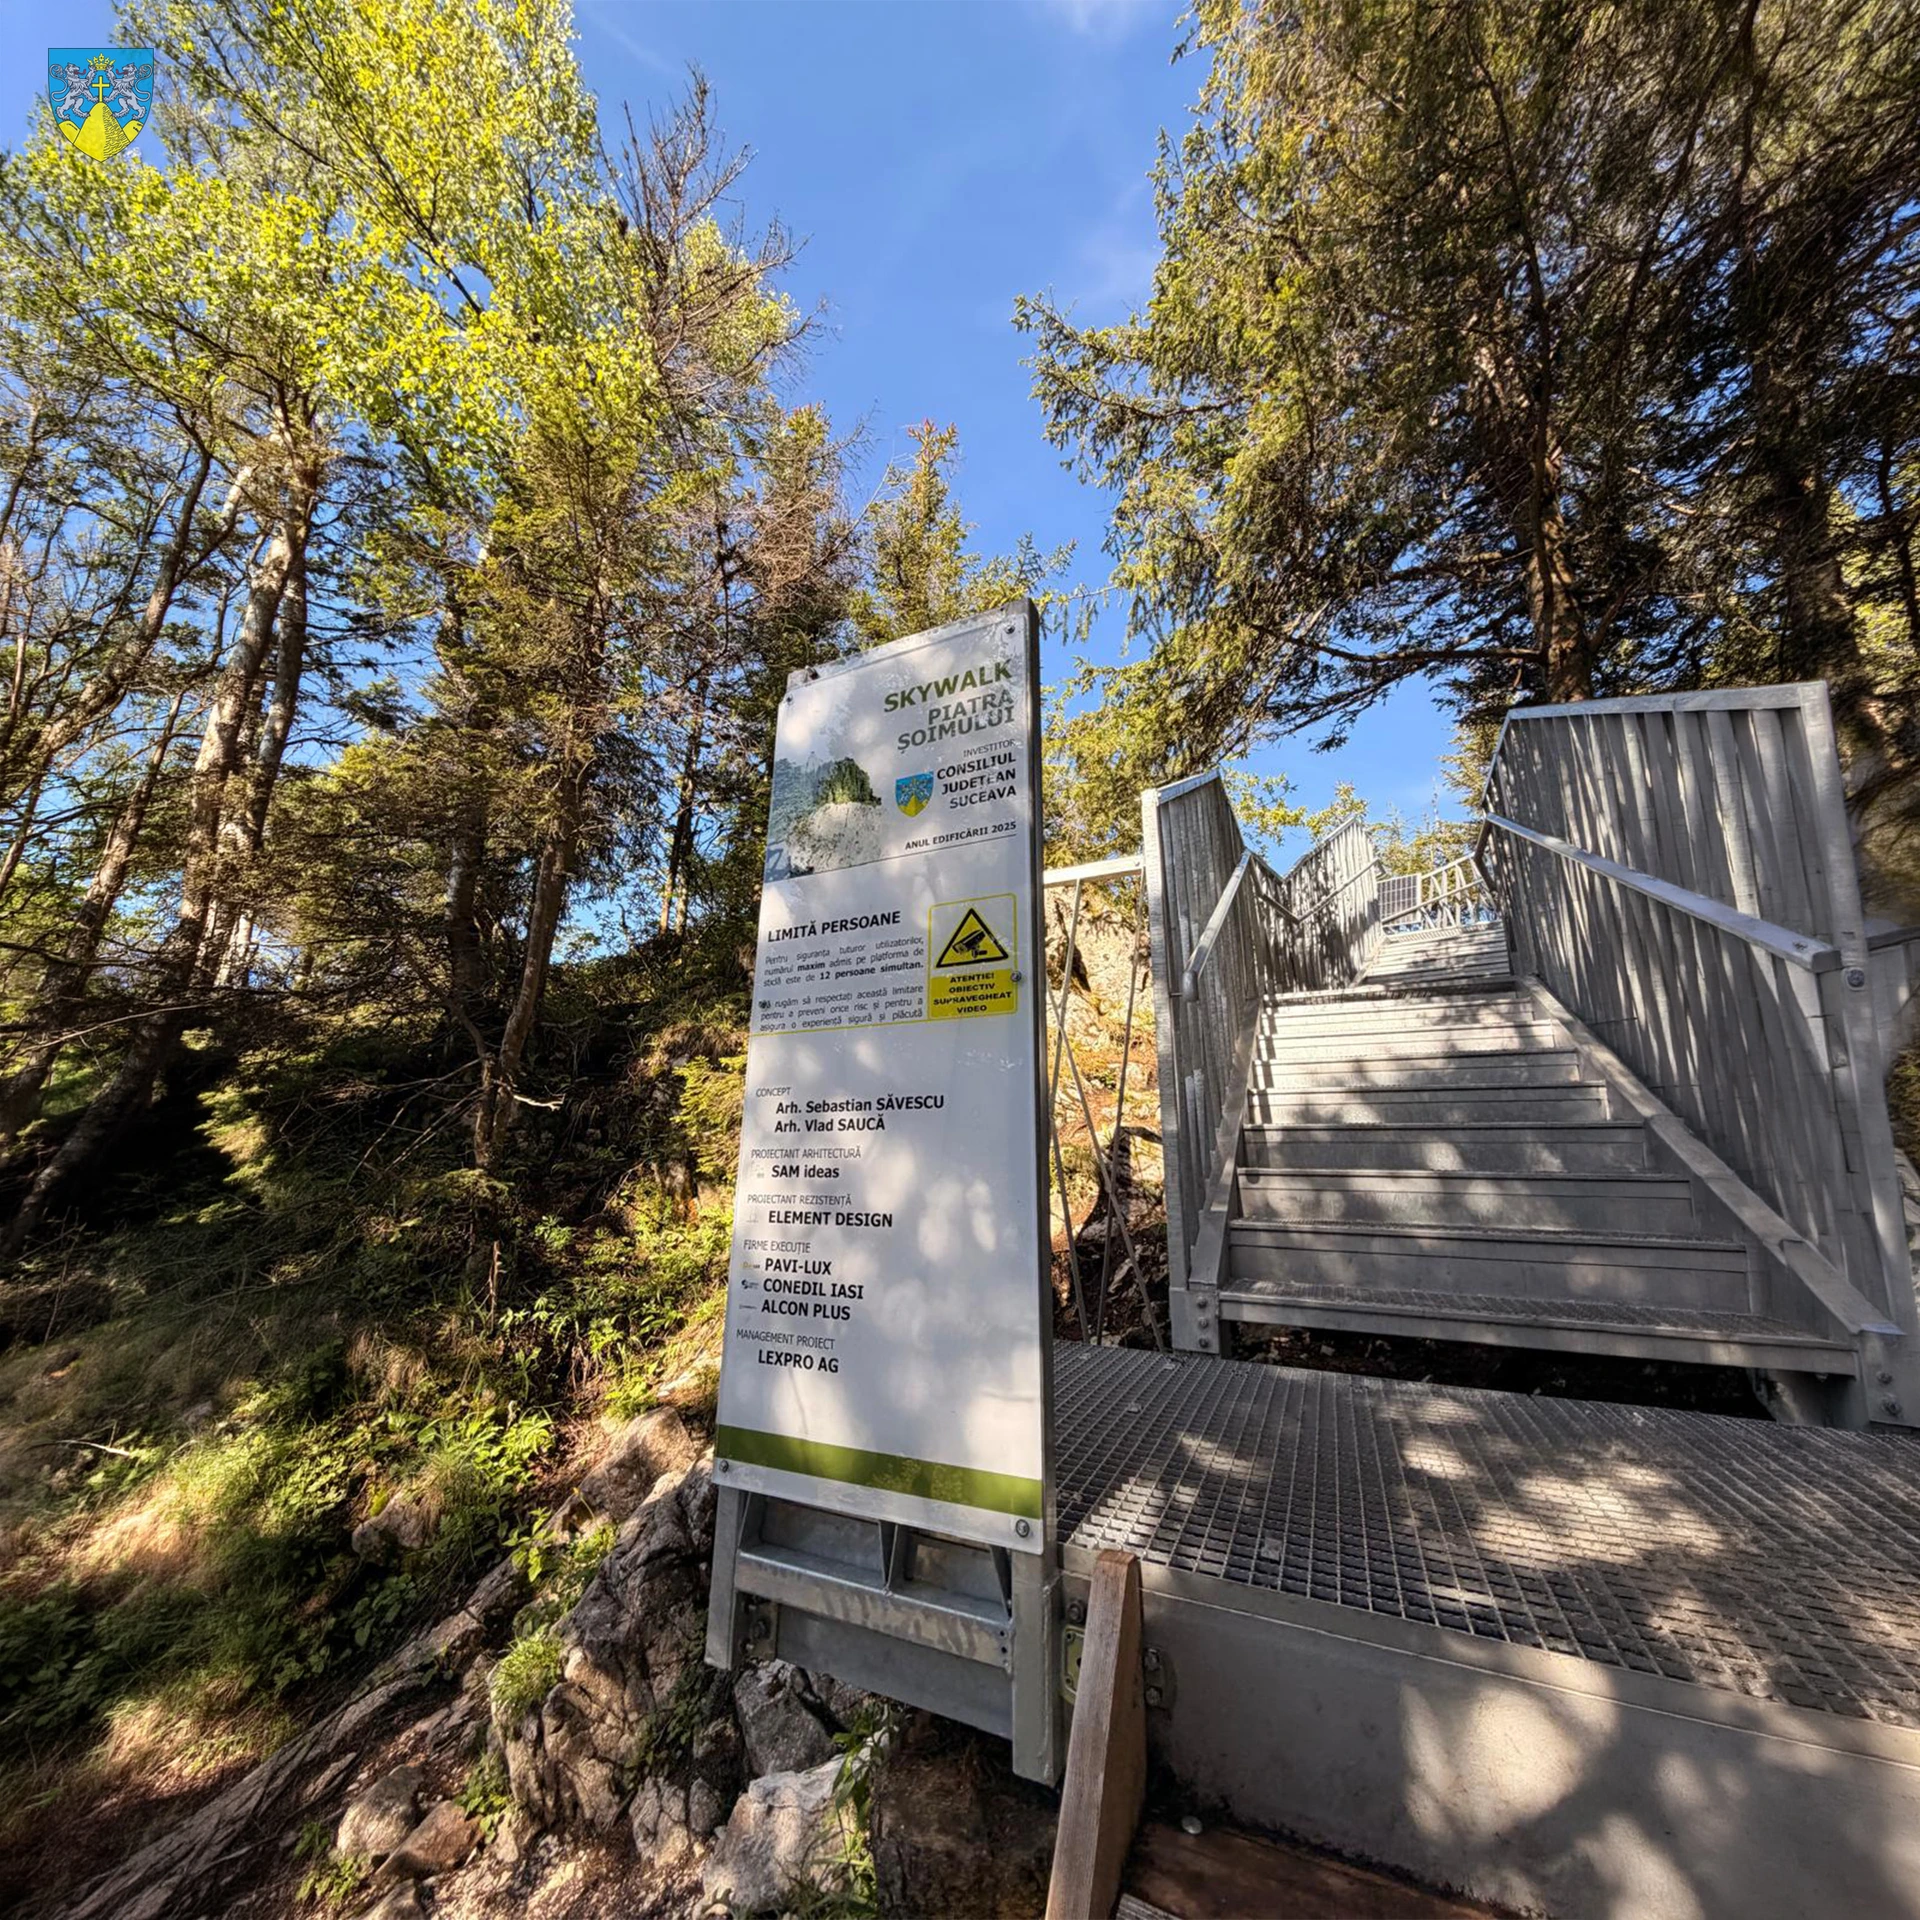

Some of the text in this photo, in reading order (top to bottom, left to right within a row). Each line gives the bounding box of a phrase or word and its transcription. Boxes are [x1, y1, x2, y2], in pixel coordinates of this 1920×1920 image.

[884, 658, 1013, 712] SKYWALK
[928, 689, 1014, 725] PIATRA
[963, 739, 1016, 758] INVESTITOR
[937, 752, 1016, 780] CONSILIUL
[941, 768, 1016, 795] JUDEȚEAN
[950, 785, 1016, 809] SUCEAVA
[905, 821, 1017, 850] ANUL EDIFICĂRII 2025
[768, 910, 901, 942] LIMITĂ PERSOANE
[765, 955, 788, 965] Pentru
[839, 944, 866, 954] tuturor
[797, 961, 826, 972] maxim
[829, 958, 852, 968] admis
[856, 956, 866, 965] pe
[870, 950, 909, 963] platforma
[913, 948, 924, 956] de
[786, 976, 801, 984] este
[805, 974, 815, 982] de
[820, 971, 831, 980] 12
[835, 967, 876, 980] persoane
[880, 961, 924, 973] simultan.
[775, 998, 798, 1008] rugăm
[802, 995, 811, 1005] să
[856, 987, 887, 999] această
[892, 985, 924, 995] limitare
[933, 991, 1012, 1005] SUPRAVEGHEAT
[949, 983, 995, 993] OBIECTIV
[760, 1011, 784, 1021] pentru
[798, 1007, 825, 1018] preveni
[854, 1003, 868, 1011] risc
[884, 998, 912, 1009] pentru
[917, 997, 923, 1005] a
[957, 1005, 987, 1014] VIDEO
[759, 1022, 786, 1032] asigura
[892, 1008, 923, 1021] plăcută
[756, 1087, 792, 1098] CONCEPT
[776, 1094, 944, 1115] Arh. Sebastian SĂVESCU
[774, 1114, 886, 1133] Arh. Vlad SAUCĂ
[751, 1145, 861, 1159] PROIECTANT ARHITECTURĂ
[771, 1165, 800, 1179] SAM
[803, 1164, 840, 1179] ideas
[747, 1194, 797, 1205] PROIECTANT
[768, 1210, 893, 1228] ELEMENT DESIGN
[743, 1239, 769, 1251] FIRME
[765, 1258, 832, 1276] PAVI-LUX
[763, 1278, 827, 1298] CONEDIL
[830, 1282, 864, 1300] IASI
[761, 1299, 851, 1320] ALCON PLUS
[736, 1328, 835, 1350] MANAGEMENT PROIECT
[758, 1349, 839, 1374] LEXPRO AG
